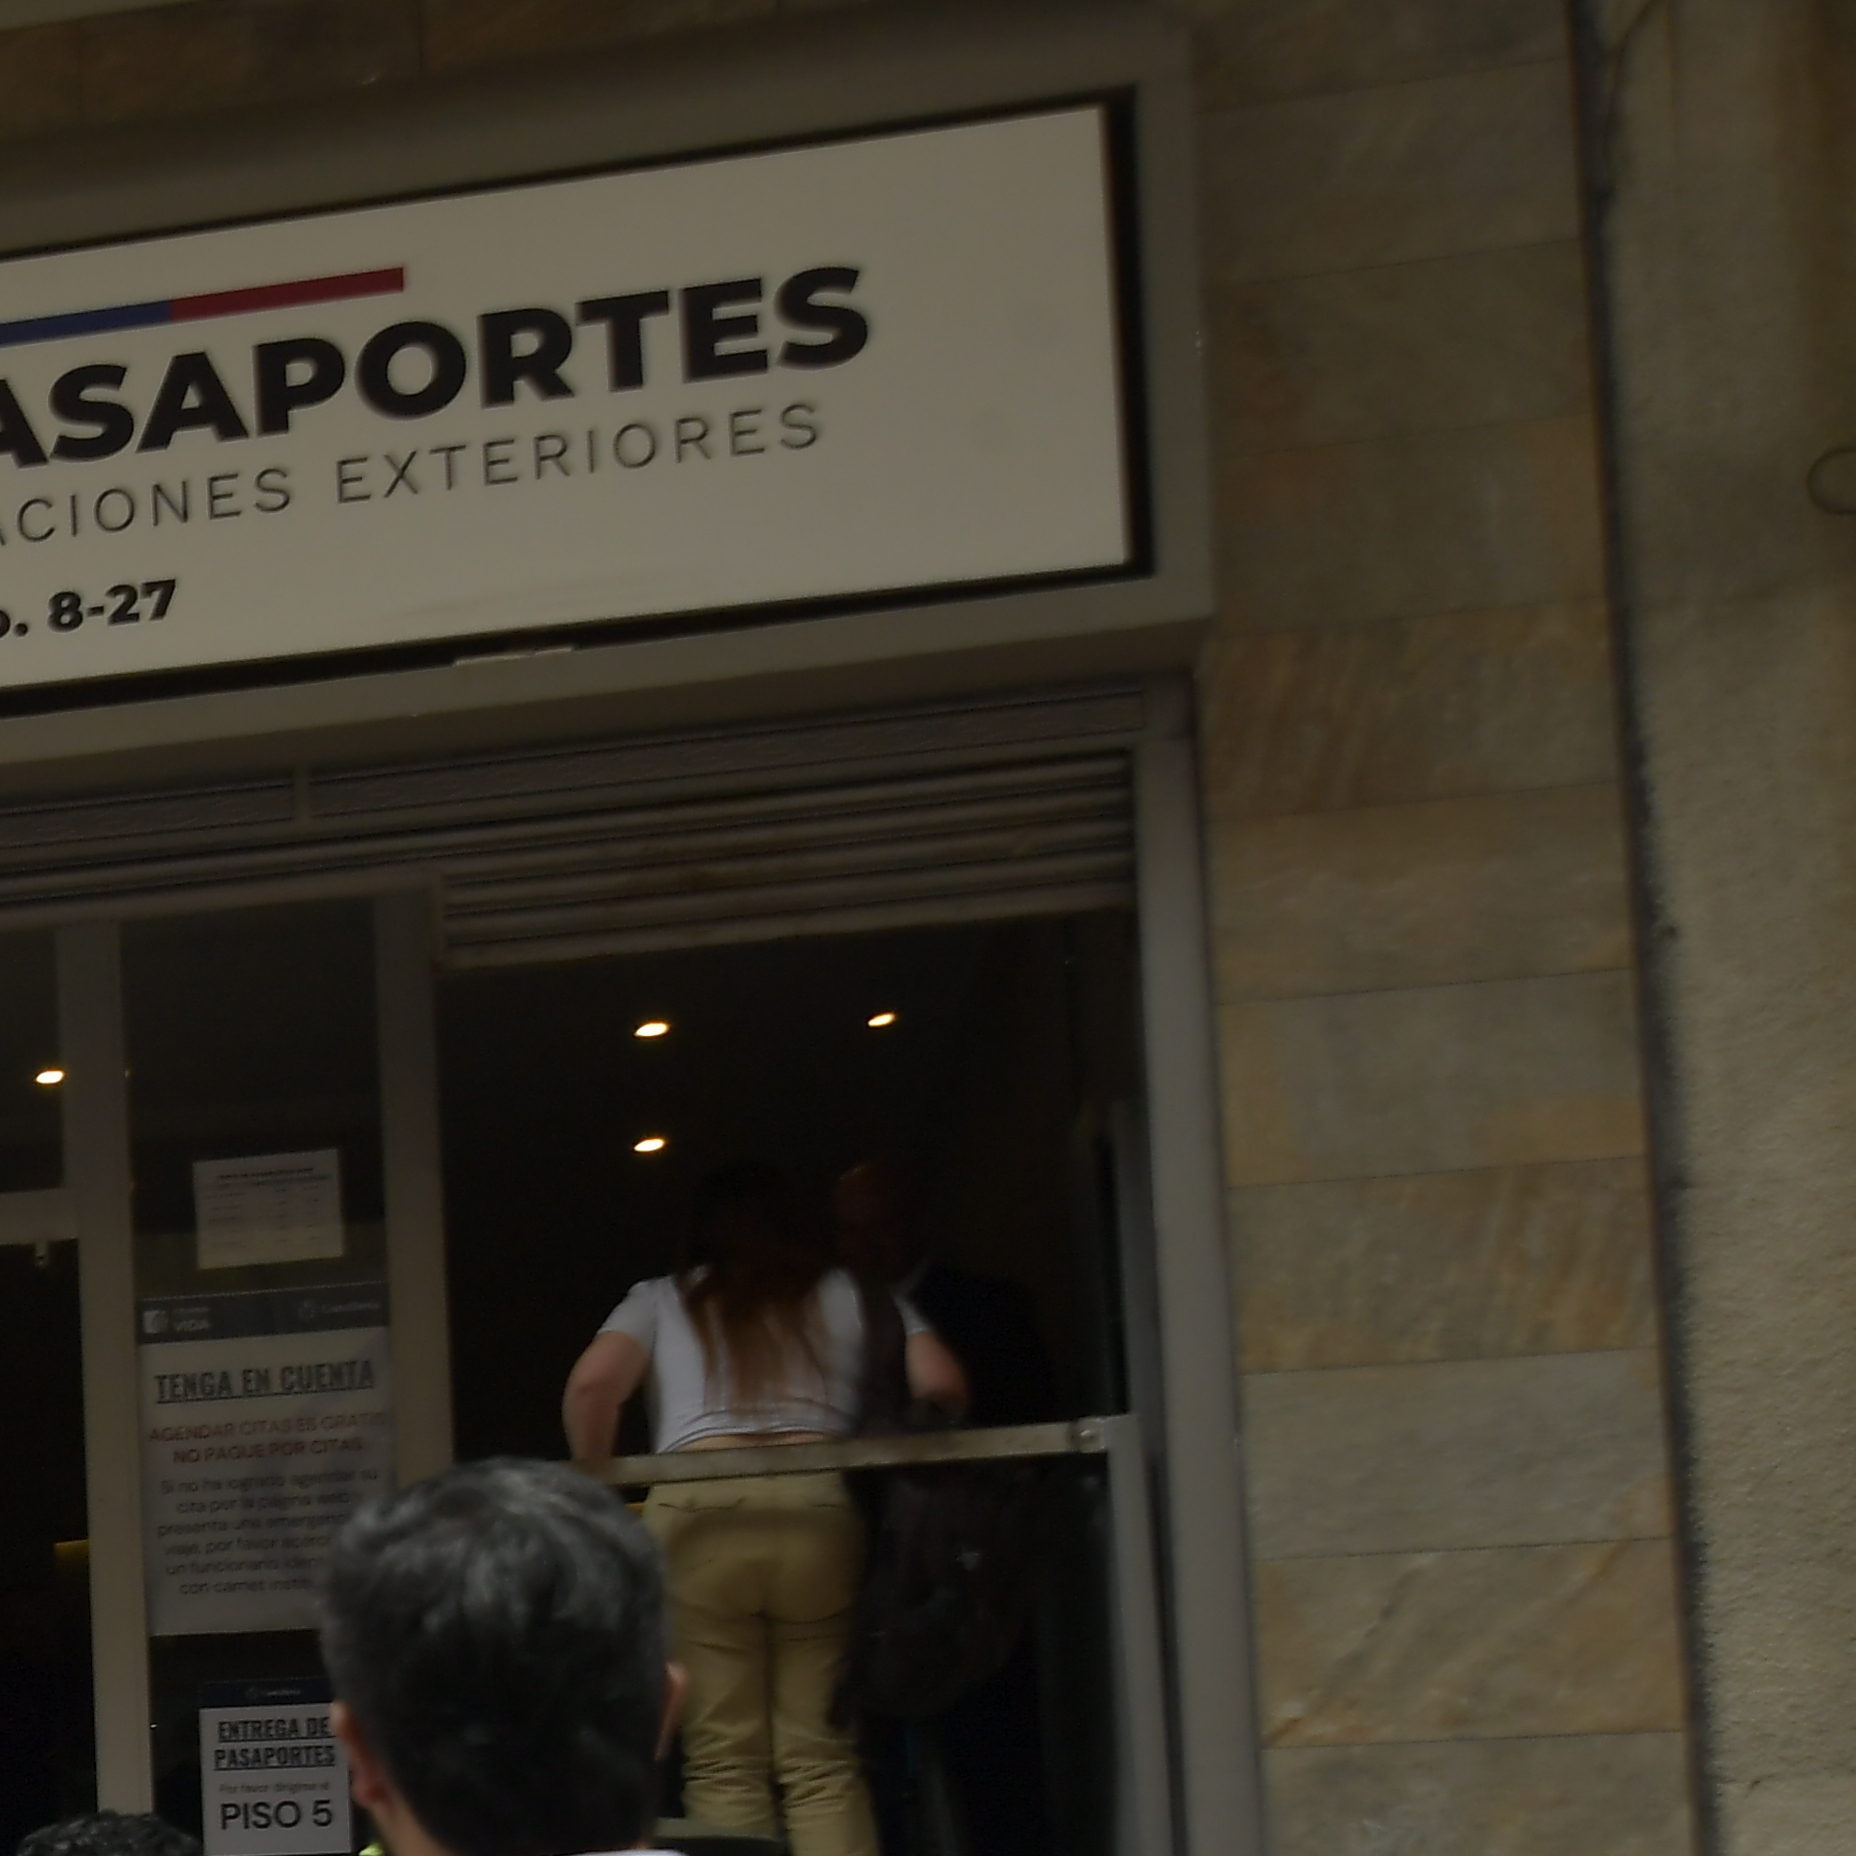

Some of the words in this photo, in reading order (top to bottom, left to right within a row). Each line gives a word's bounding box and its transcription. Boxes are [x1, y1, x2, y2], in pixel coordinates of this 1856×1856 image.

[335, 401, 821, 504] EXTERIORES
[47, 577, 179, 633] 8-27
[154, 1371, 232, 1402] TENGA
[241, 1367, 270, 1396] EN
[280, 1359, 375, 1392] CUENTA
[149, 1422, 234, 1442] AGENDAR
[239, 1420, 291, 1436] CITAS
[173, 1448, 200, 1463] NO
[218, 1718, 300, 1742] ENTREGA
[305, 1716, 332, 1739] DE
[214, 1745, 336, 1770] PASAPORTES
[220, 1800, 301, 1831] PISO
[312, 1799, 333, 1828] 5
